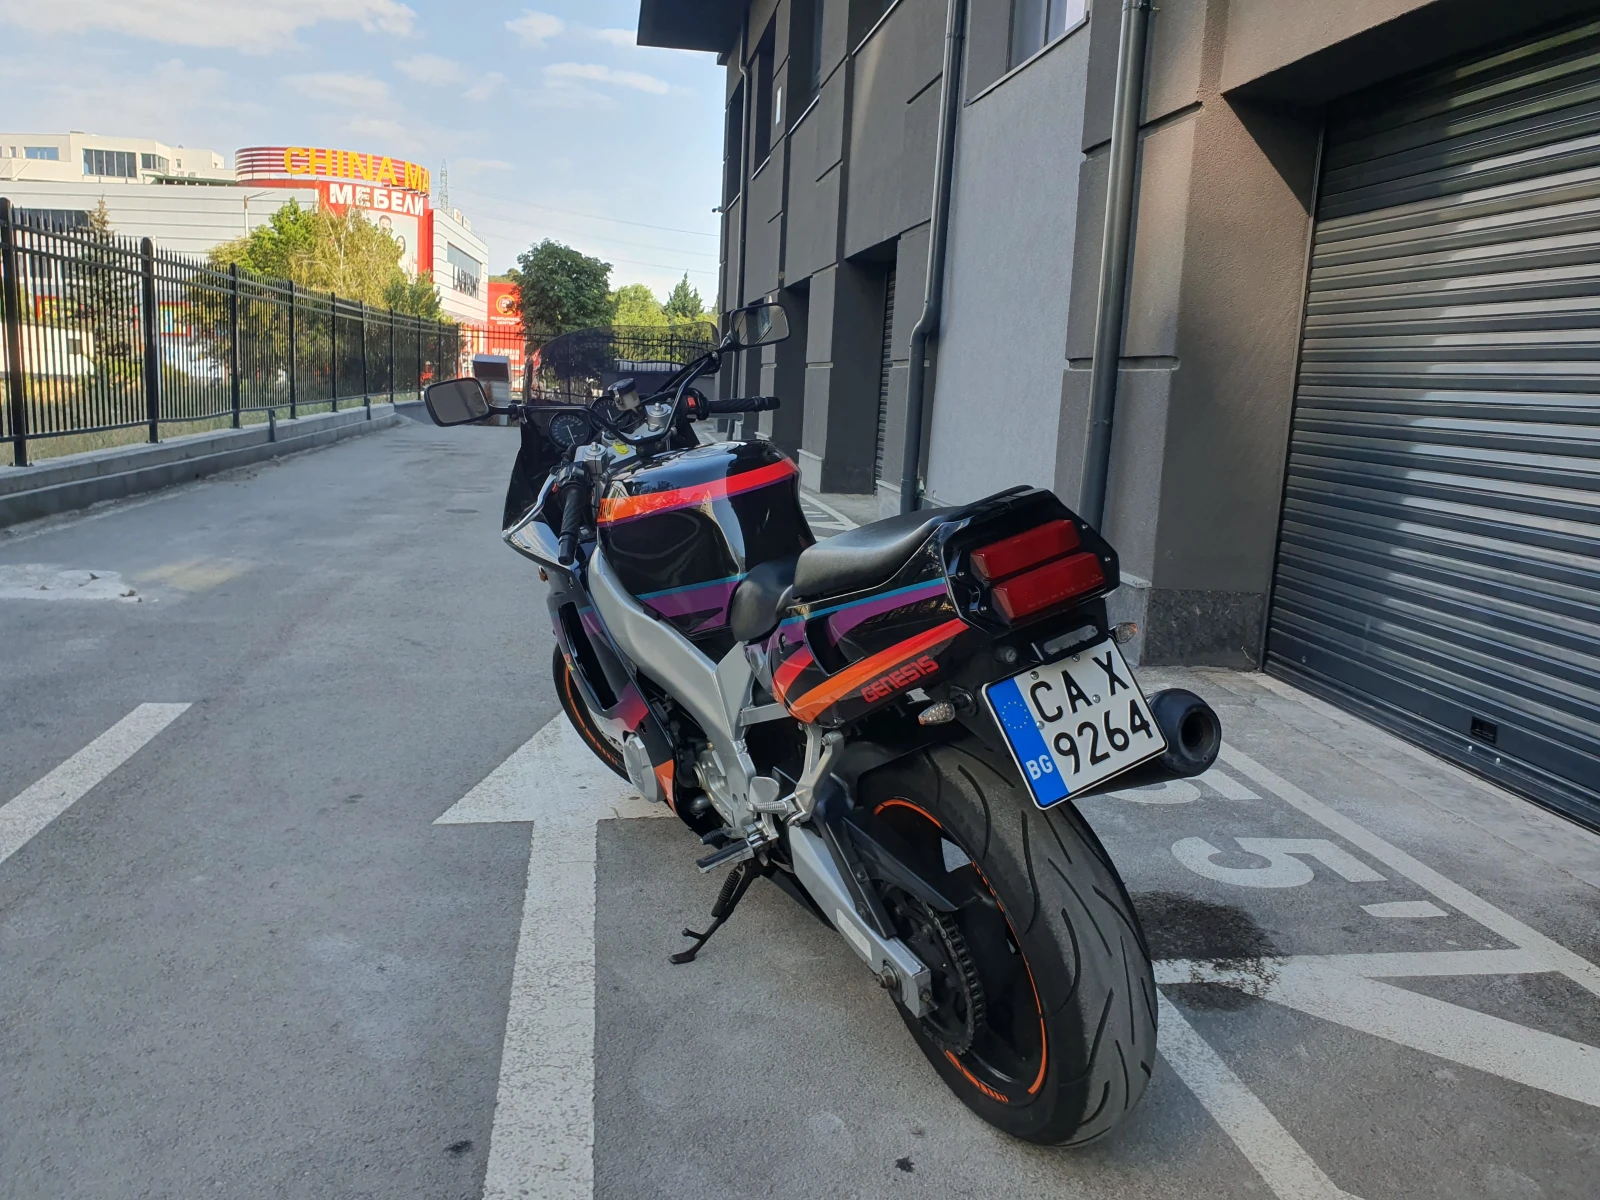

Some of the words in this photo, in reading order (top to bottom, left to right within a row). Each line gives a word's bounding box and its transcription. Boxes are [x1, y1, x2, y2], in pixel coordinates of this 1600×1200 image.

[284, 147, 397, 186] CHINA
[329, 184, 424, 216] МЕБЕЛИ
[860, 655, 940, 704] GENESIS
[1030, 669, 1092, 723] CA
[1092, 650, 1130, 696] X
[1053, 699, 1153, 776] 9264
[1025, 754, 1053, 780] BG
